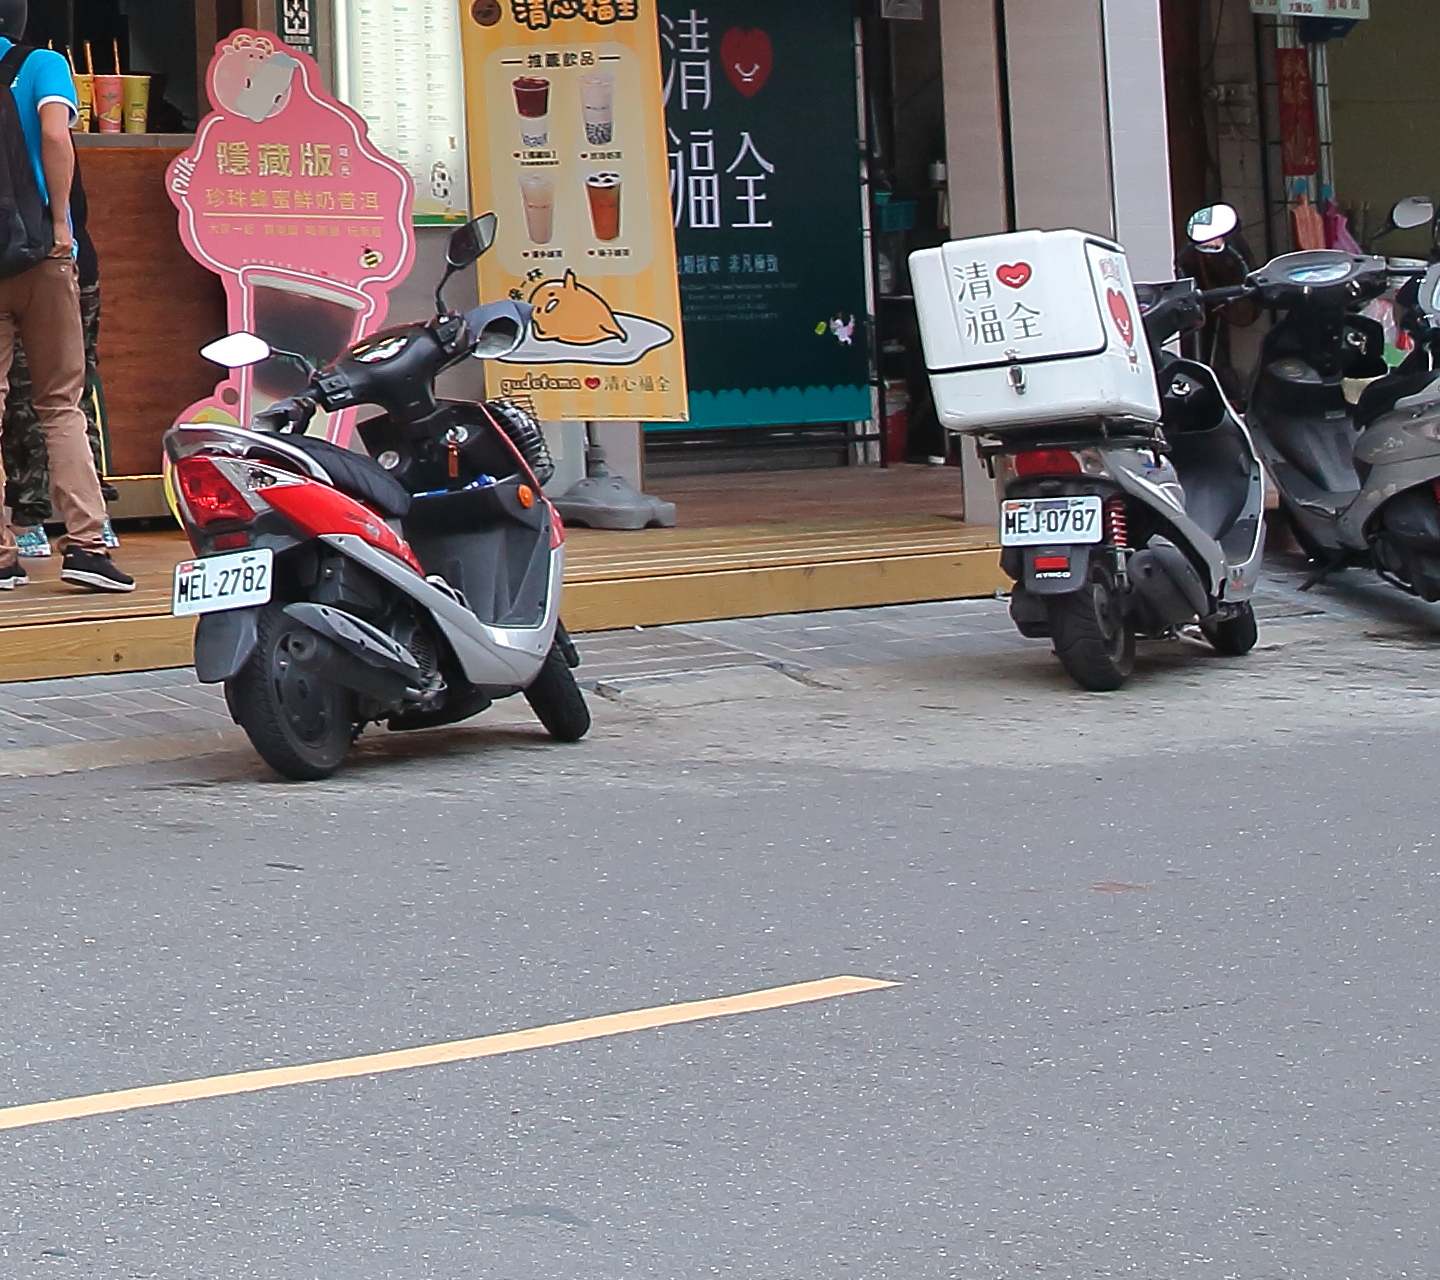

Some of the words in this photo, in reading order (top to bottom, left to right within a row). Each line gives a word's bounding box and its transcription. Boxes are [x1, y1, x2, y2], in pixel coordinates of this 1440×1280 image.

[527, 52, 594, 68] 推薦飲品
[216, 142, 333, 177] 隱藏版
[667, 129, 776, 228] 福全
[206, 188, 379, 211] 珍珠蜂蜜鮮奶普洱
[953, 260, 992, 303] 清
[964, 302, 1043, 345] 福全
[500, 373, 581, 395] gudetama
[604, 376, 670, 392] 清心福全
